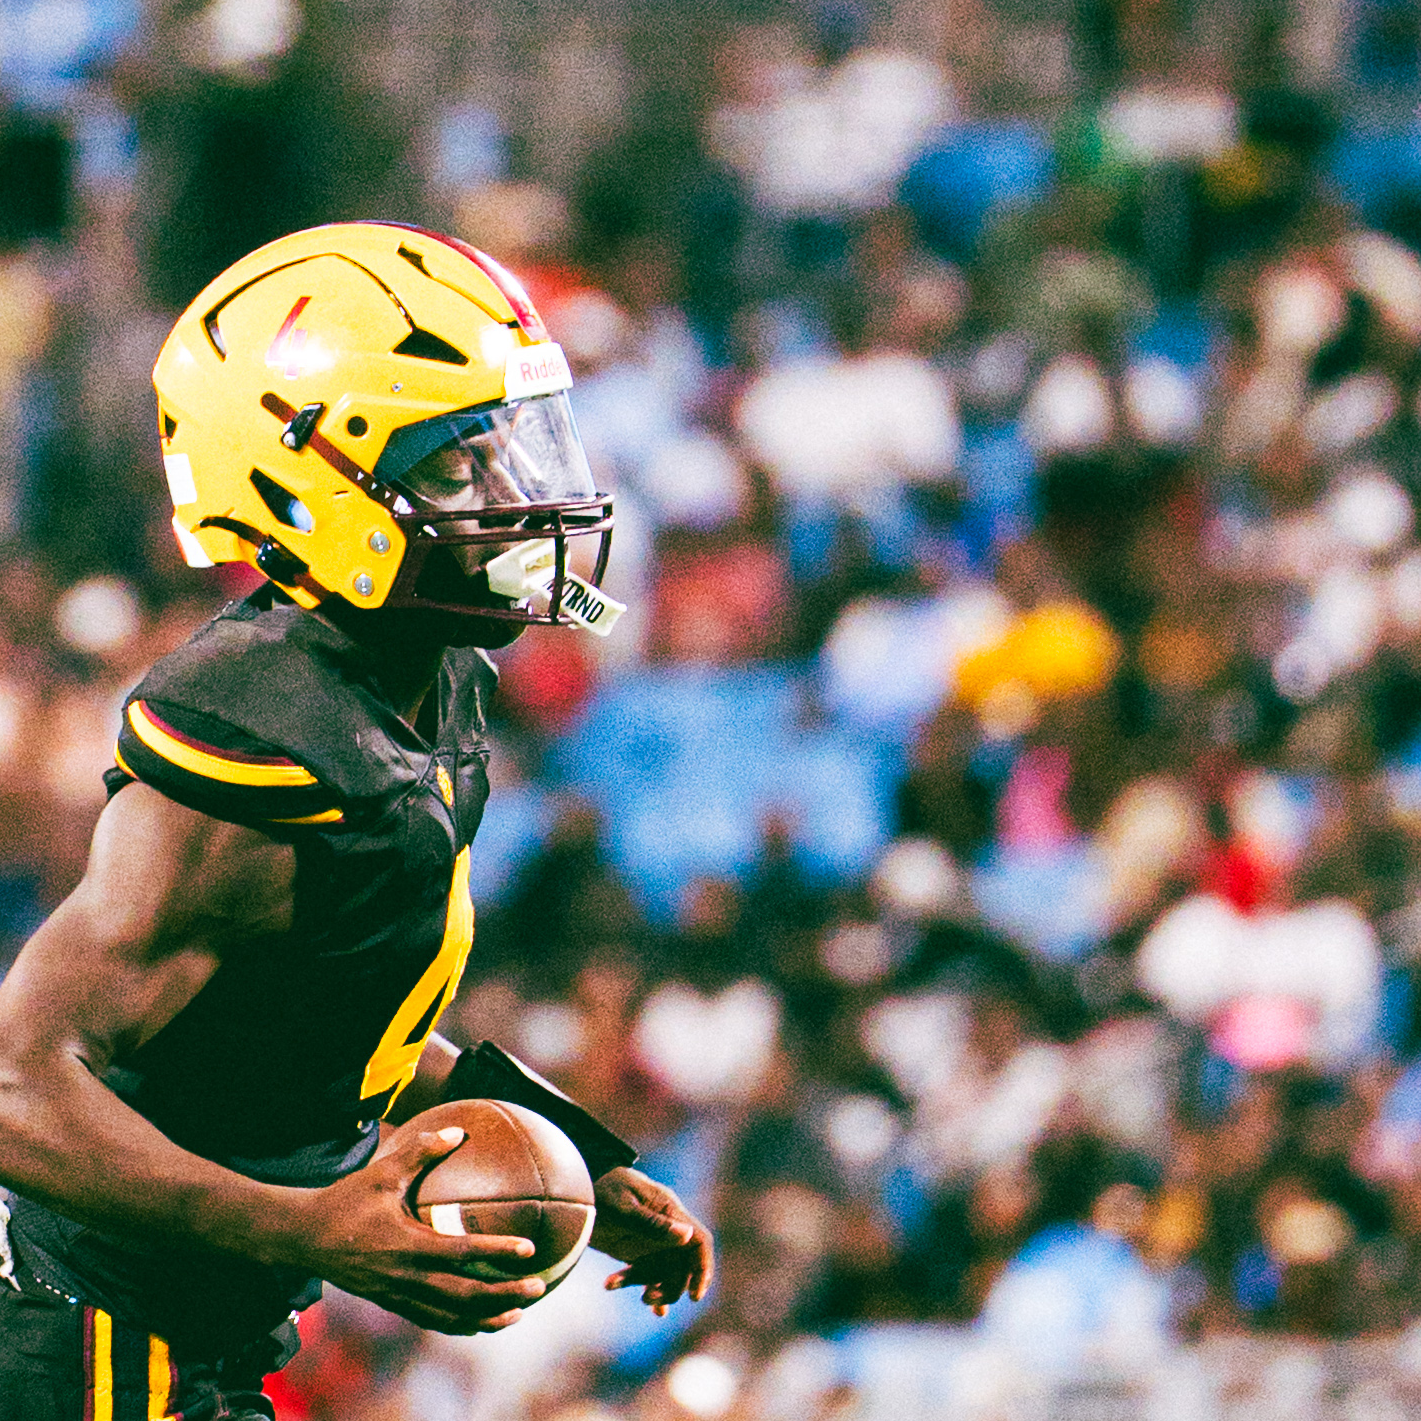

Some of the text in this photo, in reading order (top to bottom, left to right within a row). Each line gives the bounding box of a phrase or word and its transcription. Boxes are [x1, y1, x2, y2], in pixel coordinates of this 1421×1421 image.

[264, 295, 314, 380] 4
[519, 356, 564, 383] Ridde
[542, 577, 605, 624] TRND
[360, 844, 475, 1120] 4
